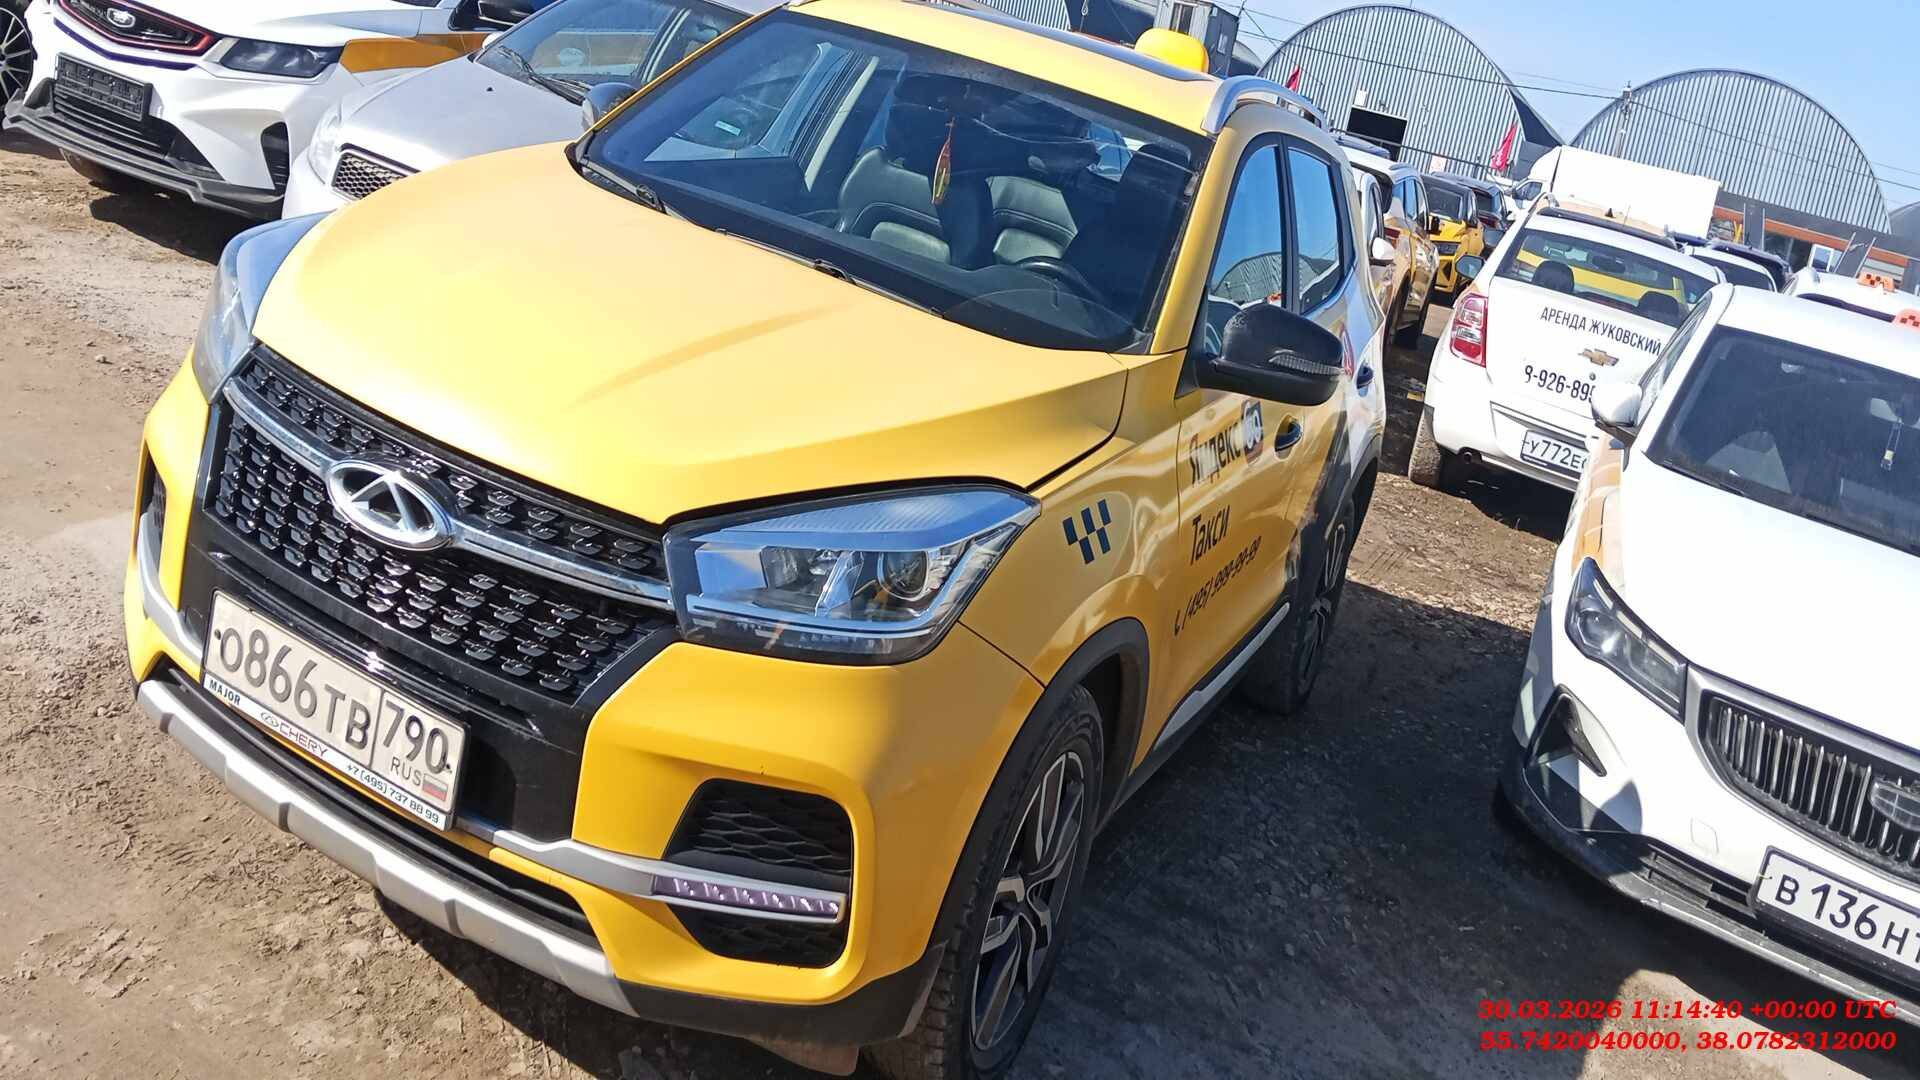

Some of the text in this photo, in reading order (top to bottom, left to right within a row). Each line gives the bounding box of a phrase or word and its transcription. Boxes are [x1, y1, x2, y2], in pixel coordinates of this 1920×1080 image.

[1540, 306, 1662, 356] АРЕНДА ЖУКОВСКИЙ
[1190, 504, 1230, 566] Такси
[209, 679, 241, 706] MAJOR
[279, 722, 328, 757] CHERY
[382, 700, 449, 775] 790
[390, 756, 422, 786] RUS
[389, 787, 409, 804] 737
